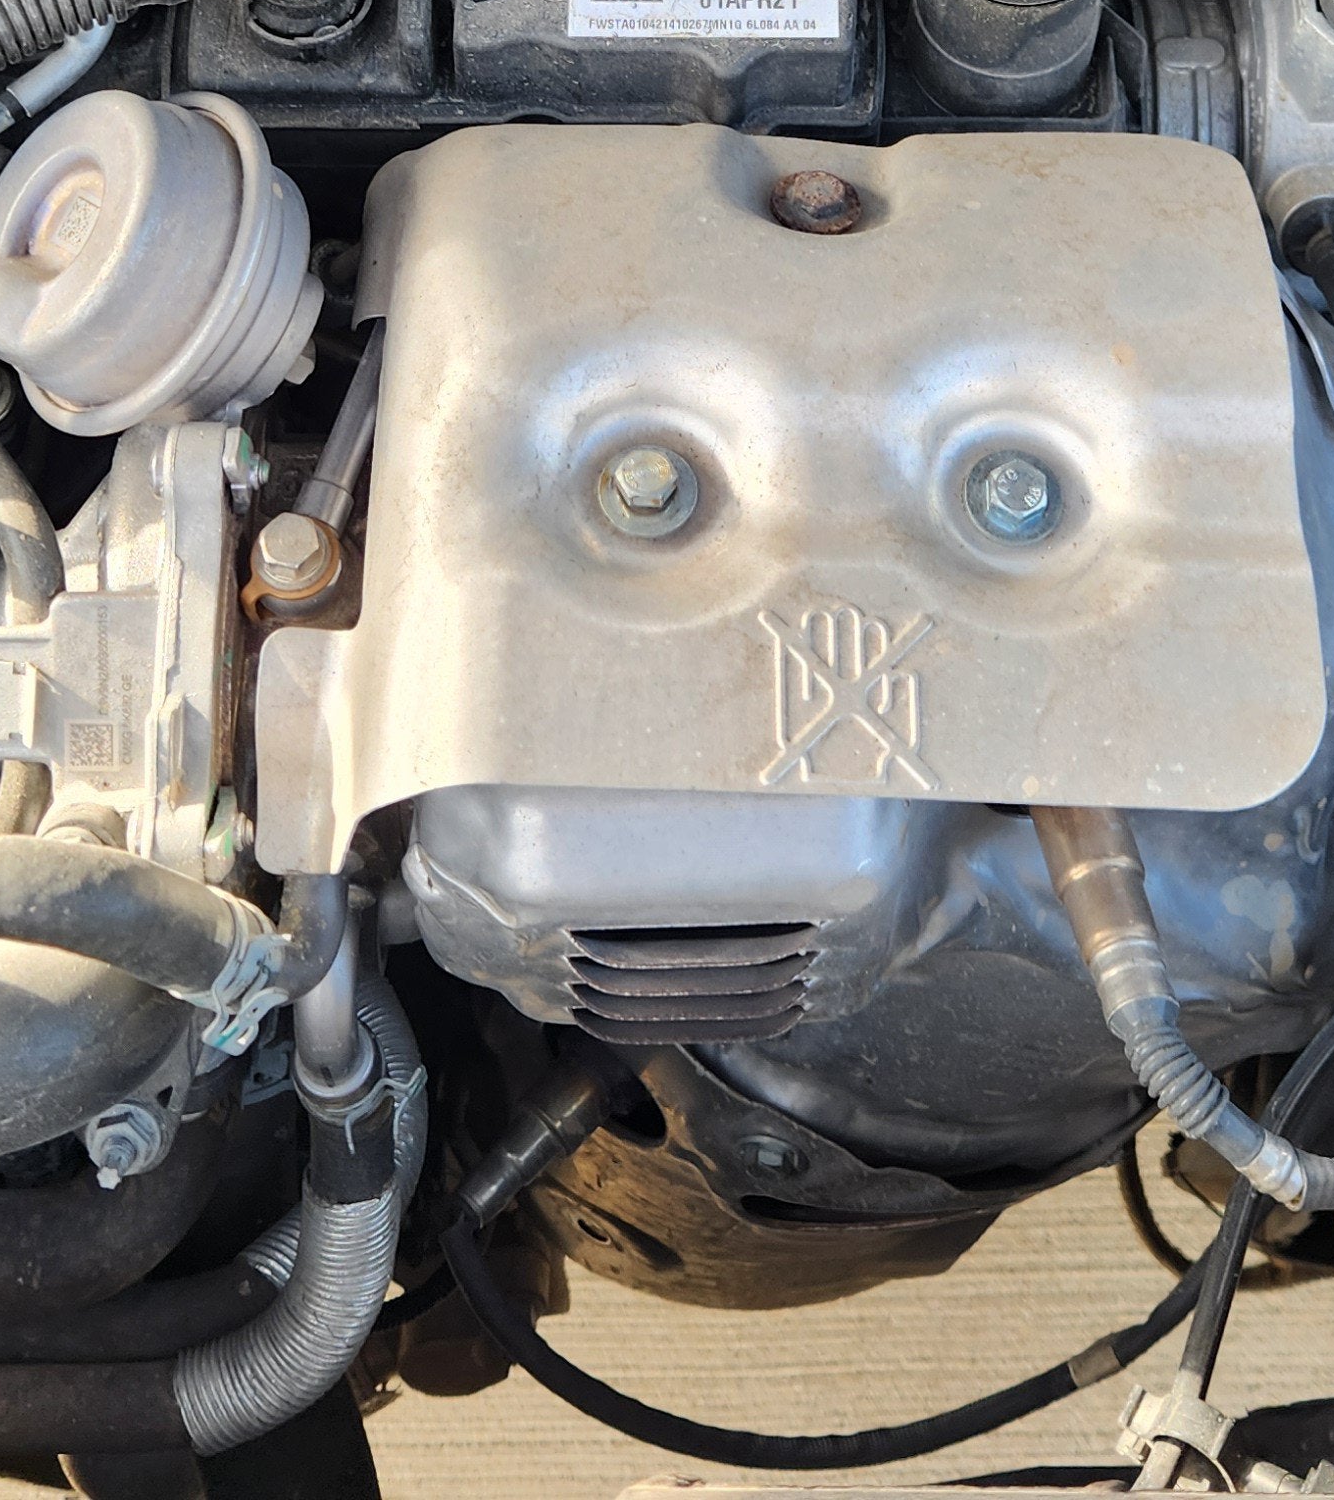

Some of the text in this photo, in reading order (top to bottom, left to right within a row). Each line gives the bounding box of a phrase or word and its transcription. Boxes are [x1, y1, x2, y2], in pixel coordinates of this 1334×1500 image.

[746, 19, 779, 30] 6L084
[783, 19, 799, 30] AA
[803, 19, 816, 30] 04
